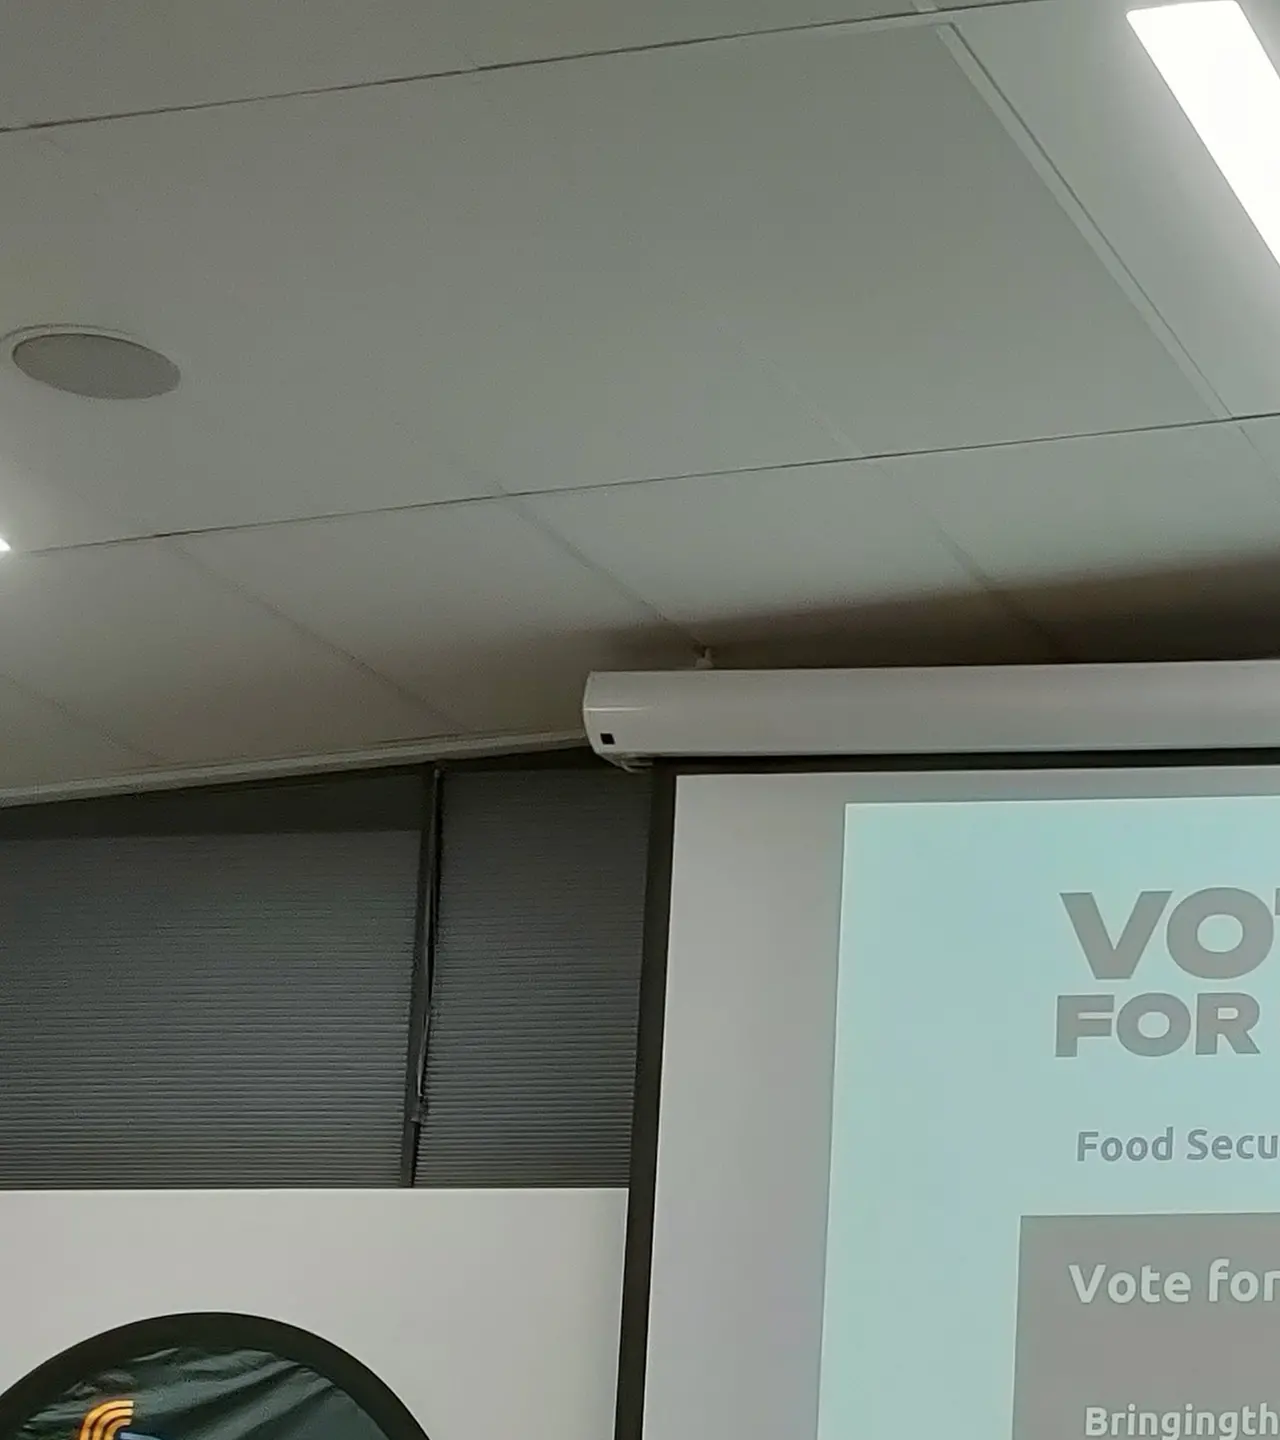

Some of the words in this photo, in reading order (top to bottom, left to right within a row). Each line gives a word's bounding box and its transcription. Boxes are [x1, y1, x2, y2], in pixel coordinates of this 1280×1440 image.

[1055, 992, 1261, 1058] FOR
[1077, 1126, 1174, 1162] Food
[1068, 1264, 1191, 1304] Vote
